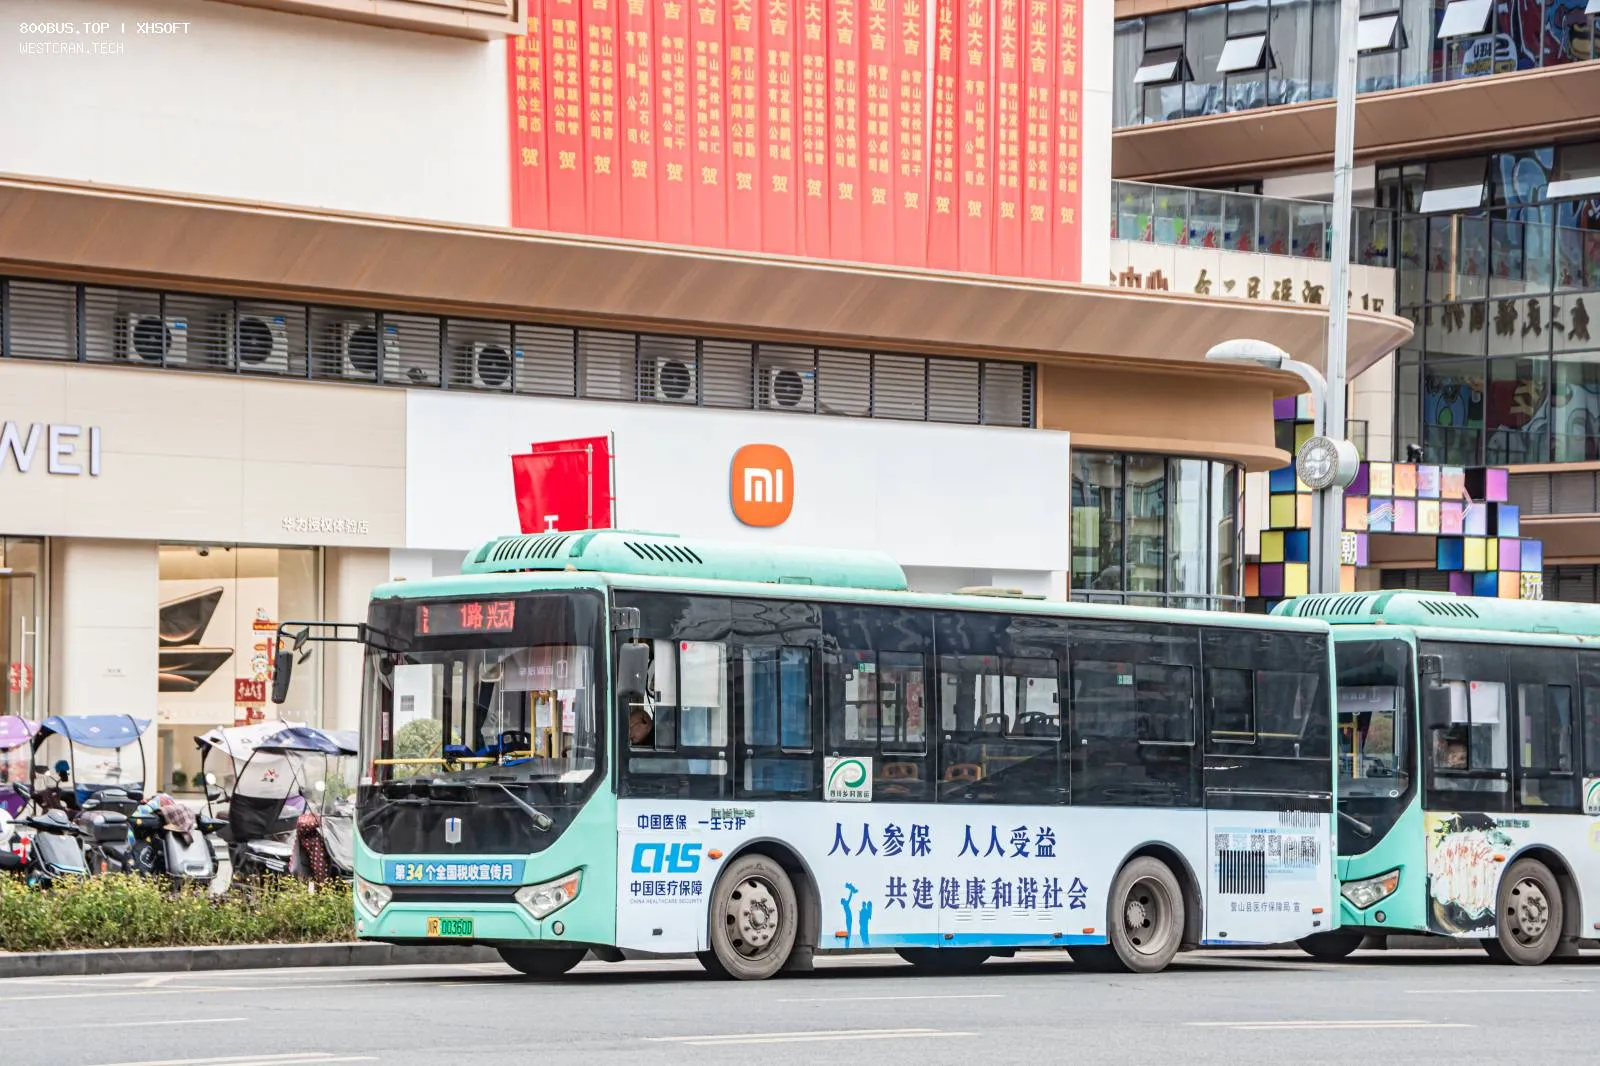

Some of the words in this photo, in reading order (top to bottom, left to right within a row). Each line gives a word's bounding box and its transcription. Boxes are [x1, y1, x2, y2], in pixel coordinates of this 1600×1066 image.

[663, 2, 681, 20] 吉
[769, 0, 787, 36] 大吉
[1031, 1, 1048, 73] 开业大吉
[1061, 3, 1076, 76] 开业大吉
[624, 30, 638, 144] 有限公司
[522, 147, 539, 167] 贺
[559, 150, 577, 170] 贺
[594, 155, 612, 174] 贺
[631, 159, 648, 179] 贺
[666, 161, 684, 182] 贺
[702, 166, 718, 185] 贺
[736, 171, 753, 191] 贺
[772, 174, 788, 193] 贺
[806, 178, 823, 198] 贺
[838, 182, 855, 201] 贺
[871, 187, 887, 205] 贺
[904, 191, 919, 209] 贺
[935, 196, 951, 214] 贺
[967, 200, 982, 218] 贺
[1000, 201, 1016, 220] 贺
[1030, 204, 1045, 222] 贺
[1060, 207, 1076, 225] 贺
[637, 814, 687, 831] 中国医保
[827, 822, 932, 857] 人人参保
[957, 824, 1057, 858] 人人受益
[395, 863, 513, 882] 第34个全国税收宣传月
[630, 880, 703, 897] 中国医疗保障
[884, 876, 1089, 910] 共建健康和谐社会
